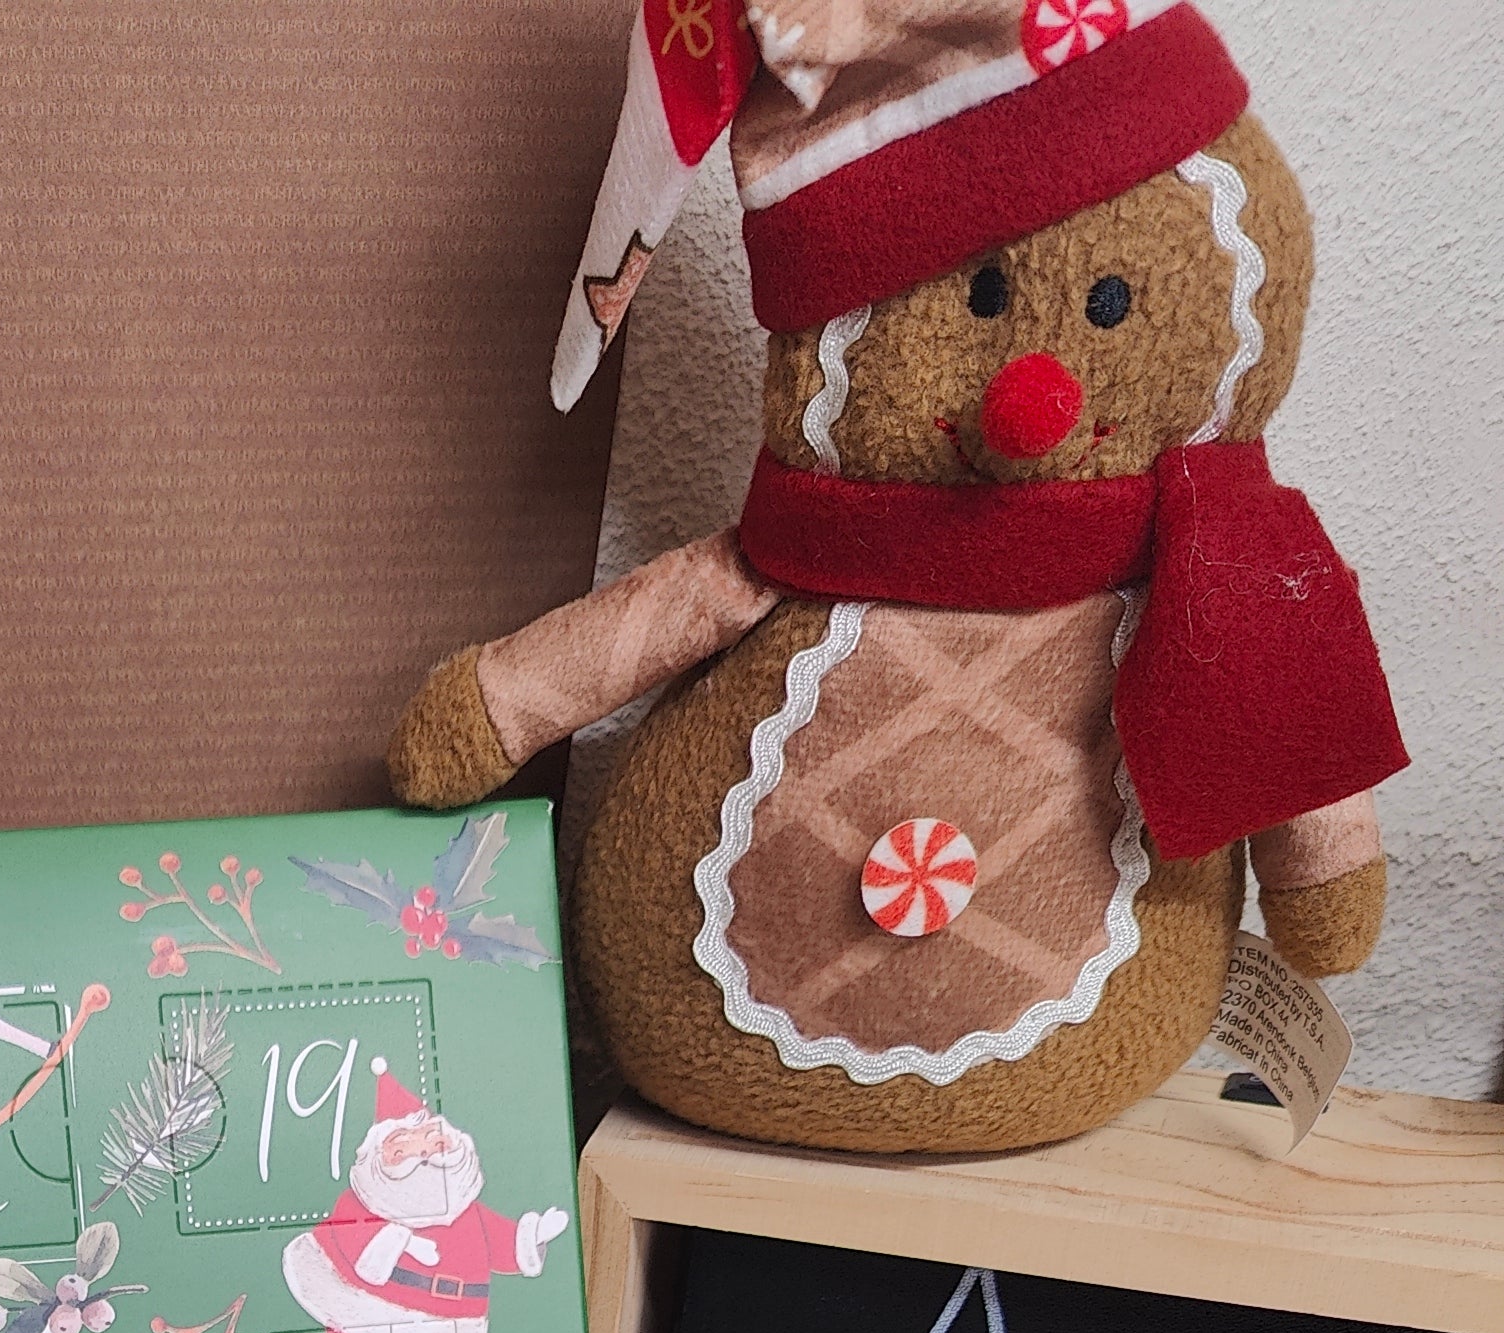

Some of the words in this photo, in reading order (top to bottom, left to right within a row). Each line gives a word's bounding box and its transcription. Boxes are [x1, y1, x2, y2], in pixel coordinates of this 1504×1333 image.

[1220, 990, 1257, 1015] 2370
[1228, 960, 1291, 1007] Distributed
[1255, 984, 1278, 1014] BOX
[1209, 1024, 1259, 1063] Fabricat
[1271, 1067, 1293, 1101] China
[1216, 1009, 1253, 1035] Made
[1253, 1028, 1264, 1045] in
[1265, 1039, 1288, 1073] China
[258, 1037, 359, 1184] 19
